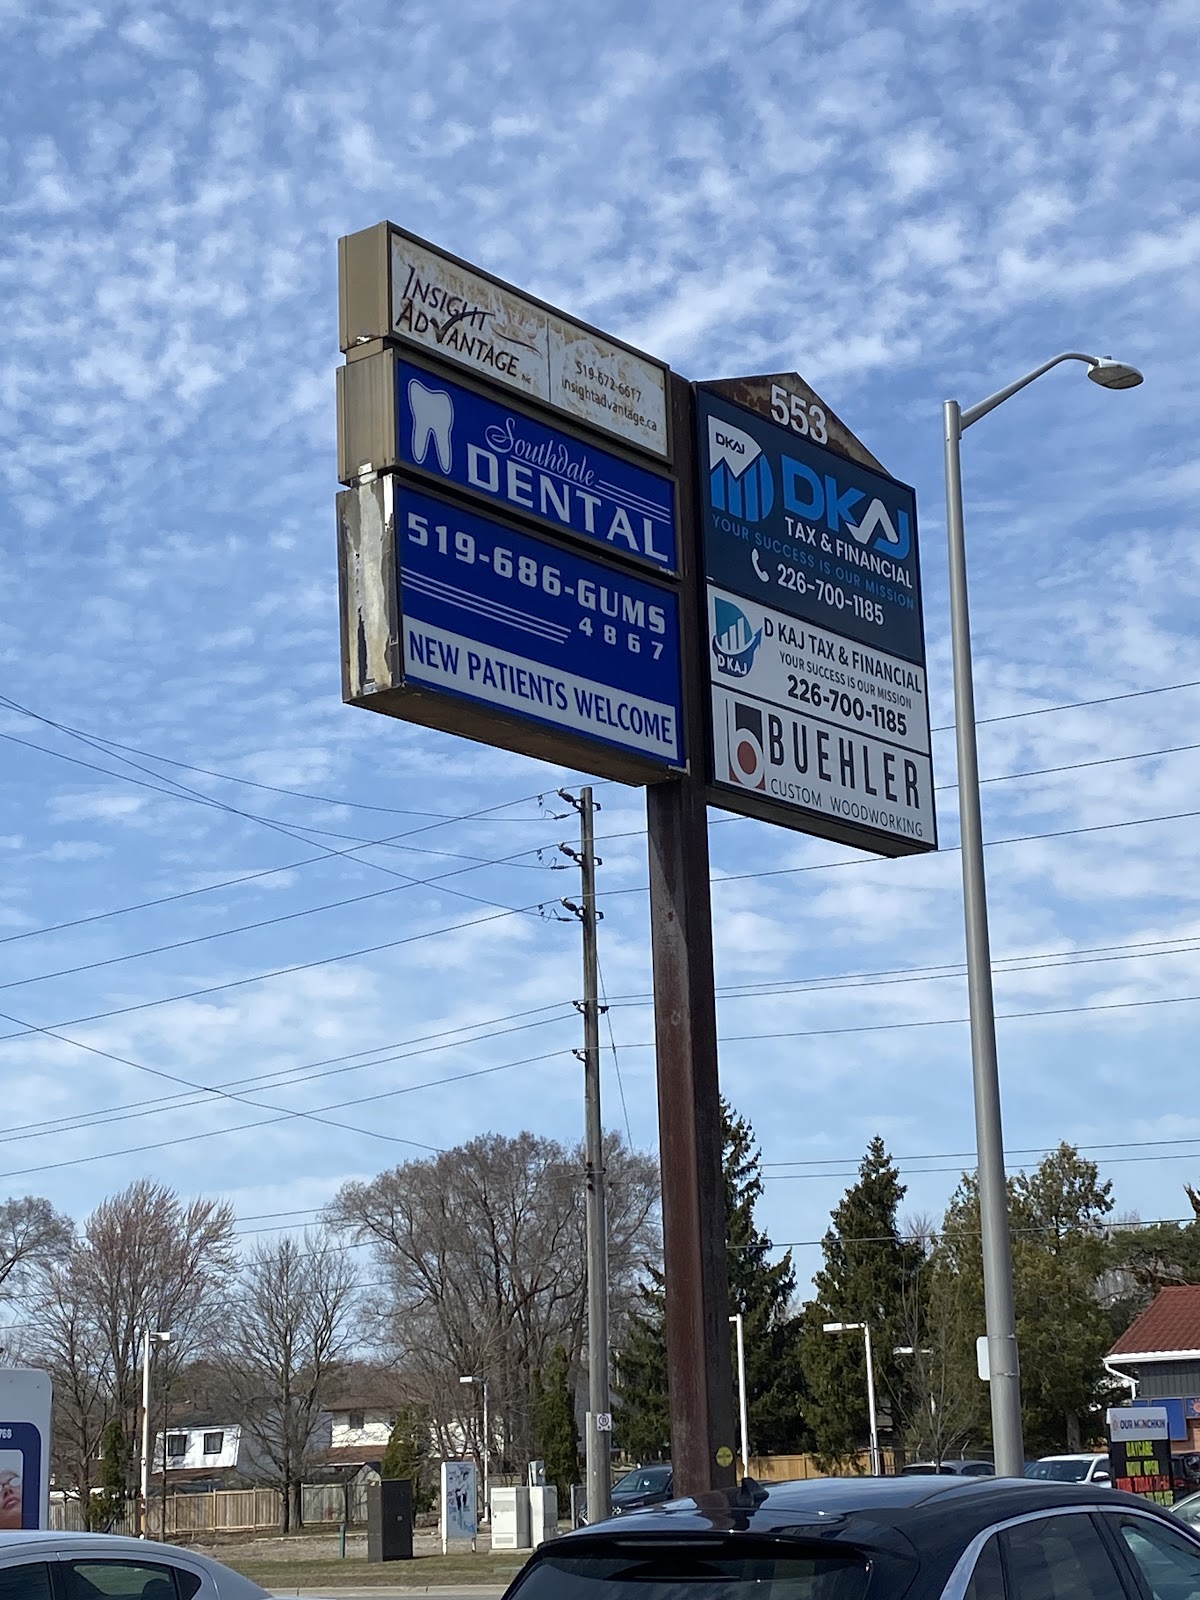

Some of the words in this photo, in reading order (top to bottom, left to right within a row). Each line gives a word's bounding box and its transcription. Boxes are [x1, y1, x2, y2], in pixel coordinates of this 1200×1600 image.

[402, 264, 488, 331] INSIGHT
[395, 297, 520, 377] ADVANTAGE
[561, 374, 657, 431] insightadvantage.ca
[770, 383, 828, 445] 553
[485, 417, 595, 486] Southdale
[715, 432, 745, 455] DKAJ
[466, 442, 669, 563] DENTAL
[780, 453, 911, 560] DKAJ
[407, 511, 666, 635] 519-686-GUMS
[712, 514, 749, 541] YOUR
[754, 532, 815, 568] SUCCESS
[819, 559, 831, 575] IS
[835, 567, 861, 589] OUR
[865, 579, 914, 610] MISSION
[784, 516, 817, 547] TAX
[820, 533, 833, 554] &
[836, 539, 913, 589] FINANCIAL
[777, 563, 885, 626] 226-700-1185
[408, 630, 460, 676] NEW
[467, 651, 568, 711] PATIENTS
[573, 687, 673, 745] WELCOME
[777, 622, 805, 650] KAJ
[808, 633, 835, 662] TAX
[838, 645, 849, 667] &
[852, 650, 922, 694] FINANCIAL
[779, 650, 805, 671] YOUR
[806, 660, 845, 686] SUCCESS
[847, 675, 856, 689] IS
[857, 679, 876, 696] OUR
[877, 686, 912, 710] MISSION
[787, 674, 907, 736] 226-700-1185
[768, 713, 921, 810] BUEHLER
[770, 778, 823, 808] CUSTOM
[830, 795, 923, 838] WOODWORKING
[1120, 1420, 1133, 1430] OUR
